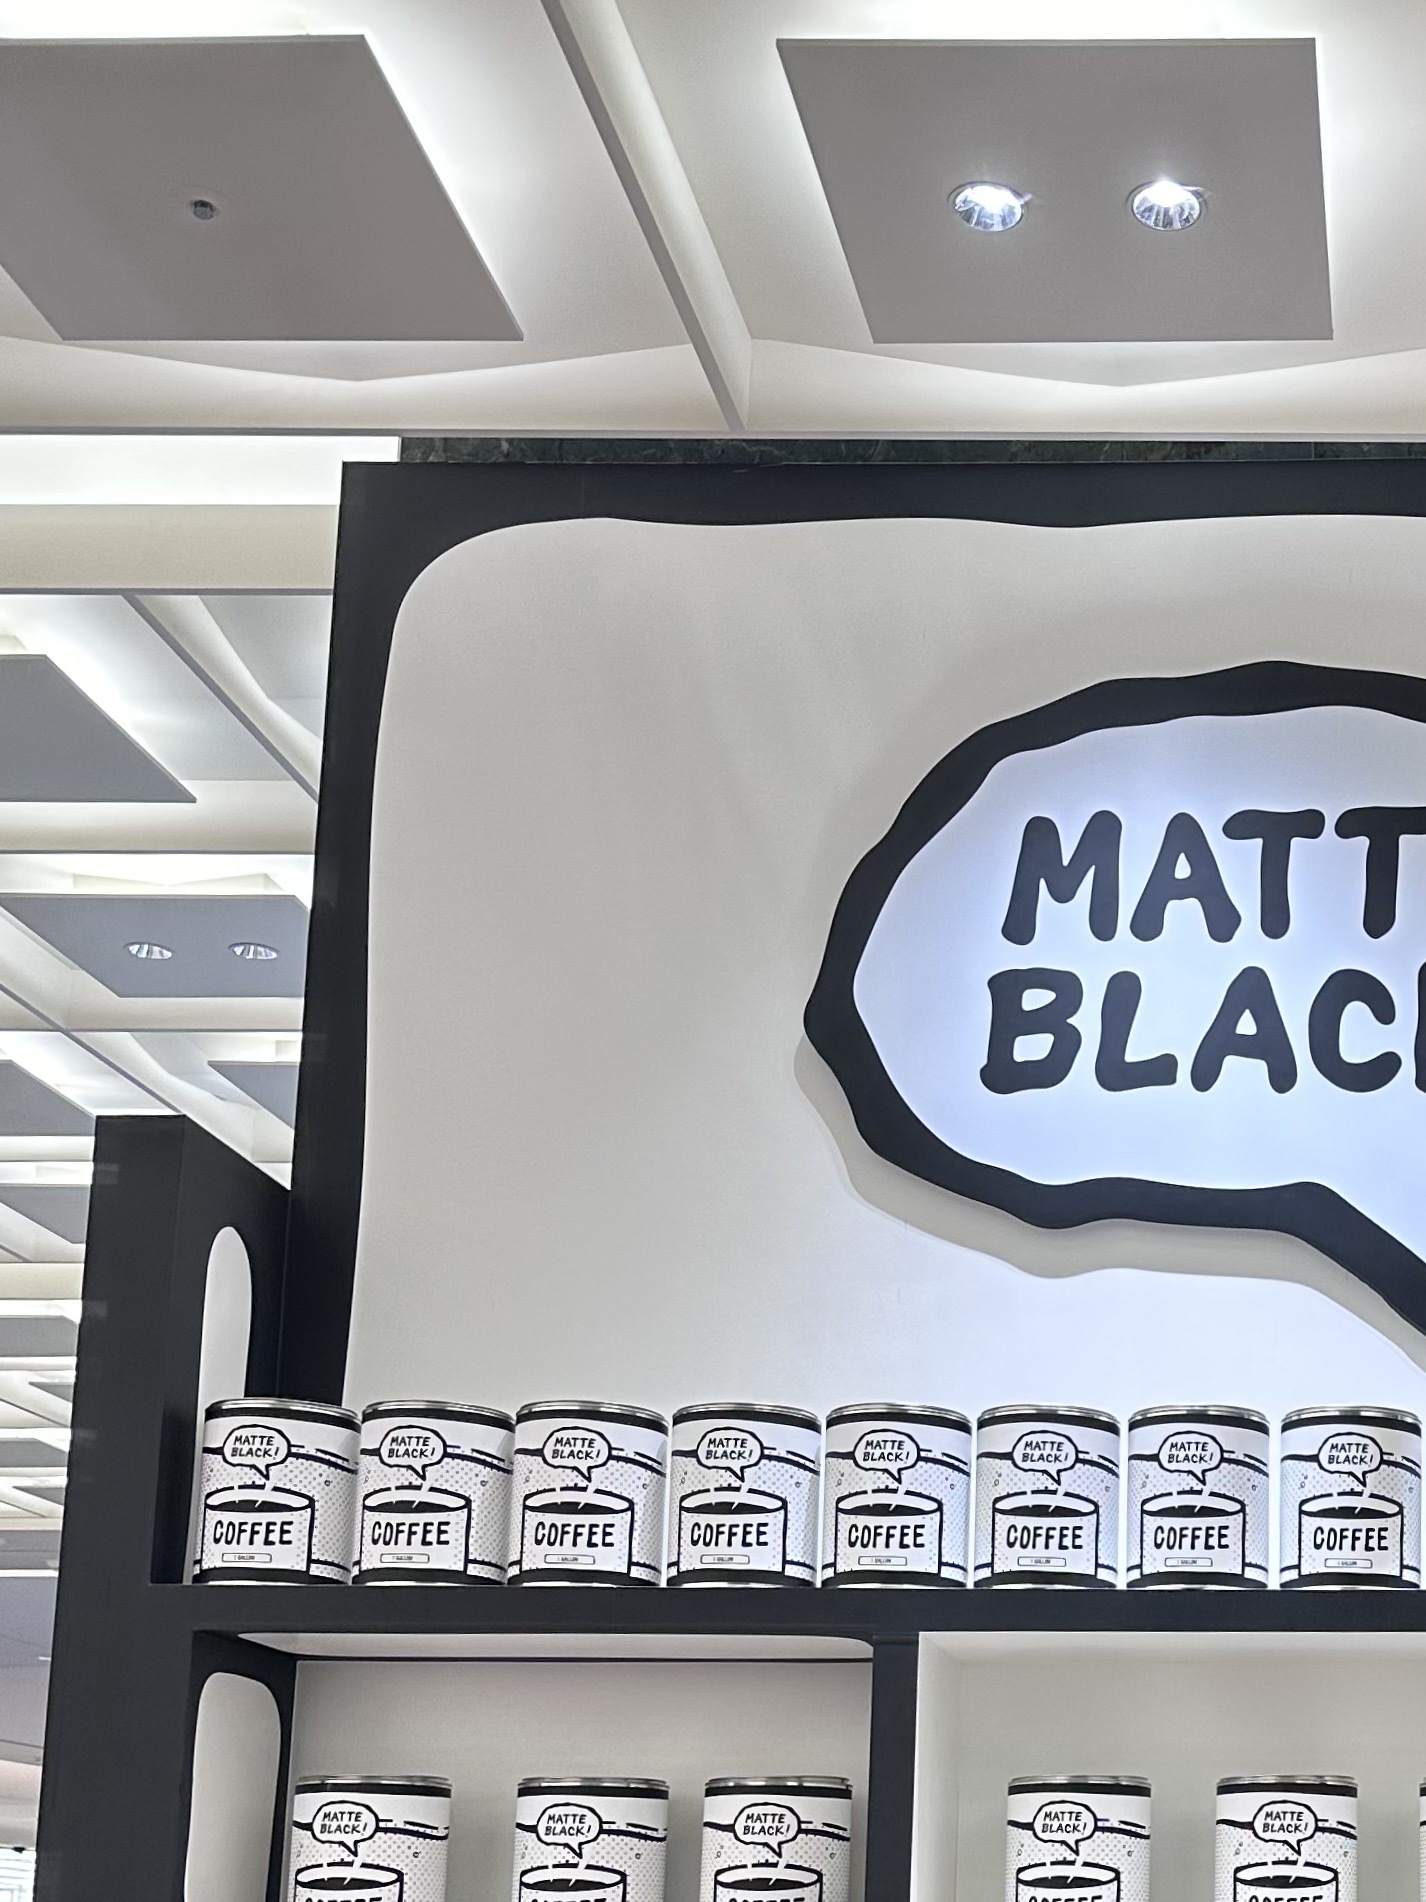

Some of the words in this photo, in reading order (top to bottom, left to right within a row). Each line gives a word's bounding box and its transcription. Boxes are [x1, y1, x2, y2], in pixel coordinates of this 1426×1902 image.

[234, 1435, 275, 1446] MATTE
[390, 1436, 431, 1446] MATTE
[554, 1437, 596, 1448] MATTE
[707, 1438, 748, 1448] MATTE
[865, 1440, 905, 1450] MATTE
[1024, 1440, 1064, 1452] MATTE
[1169, 1441, 1209, 1452] MATTE
[1330, 1443, 1369, 1453] MATTE
[231, 1447, 279, 1458] BLACK!
[388, 1447, 435, 1459] BLACK!
[552, 1449, 600, 1460] BLACK!
[705, 1449, 753, 1460] BLACK!
[863, 1451, 909, 1462] BLACK!
[1022, 1453, 1068, 1463] BLACK!
[1168, 1452, 1213, 1464] BLACK!
[1328, 1454, 1373, 1465] BLACK!
[213, 1520, 294, 1546] COFFEE
[371, 1521, 451, 1546] COFFEE
[534, 1521, 615, 1548] COFFEE
[691, 1522, 769, 1547] COFFEE
[848, 1524, 925, 1549] COFFEE
[1006, 1524, 1083, 1550] COFFEE
[1154, 1525, 1229, 1550] COFFEE
[1313, 1526, 1389, 1552] COFFEE
[322, 1811, 363, 1822] MATTE
[547, 1814, 587, 1824] MATTE
[745, 1813, 786, 1824] MATTE
[1043, 1811, 1082, 1822] MATTE
[1264, 1811, 1304, 1821] MATTE
[320, 1823, 367, 1834] BLACK!
[545, 1825, 591, 1836] BLACK!
[743, 1824, 790, 1836] BLACK!
[1042, 1822, 1087, 1833] BLACK!
[1262, 1823, 1308, 1833] BLACK!
